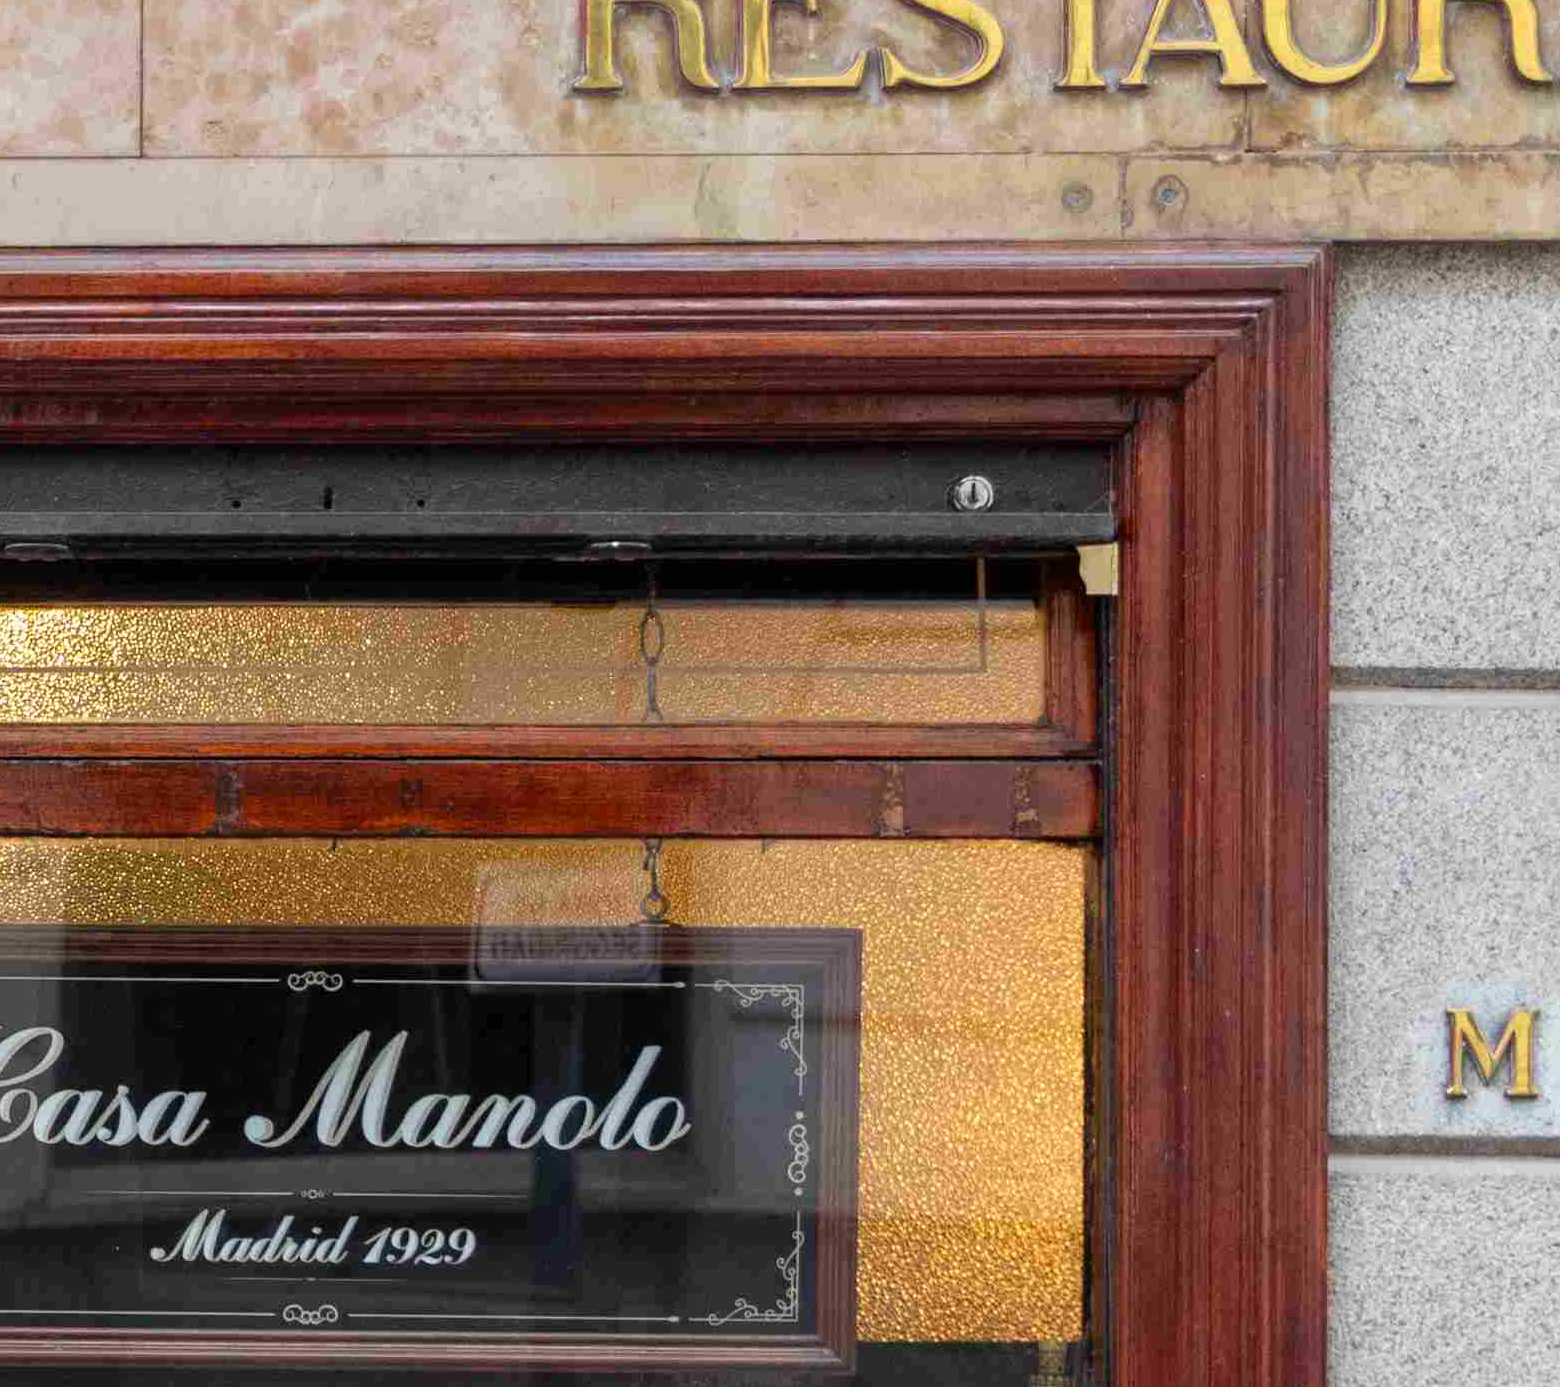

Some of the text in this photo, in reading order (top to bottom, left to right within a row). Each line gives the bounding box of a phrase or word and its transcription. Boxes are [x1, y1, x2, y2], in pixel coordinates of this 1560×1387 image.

[245, 1029, 691, 1151] Manolo
[150, 1207, 476, 1266] Madrid 1929
